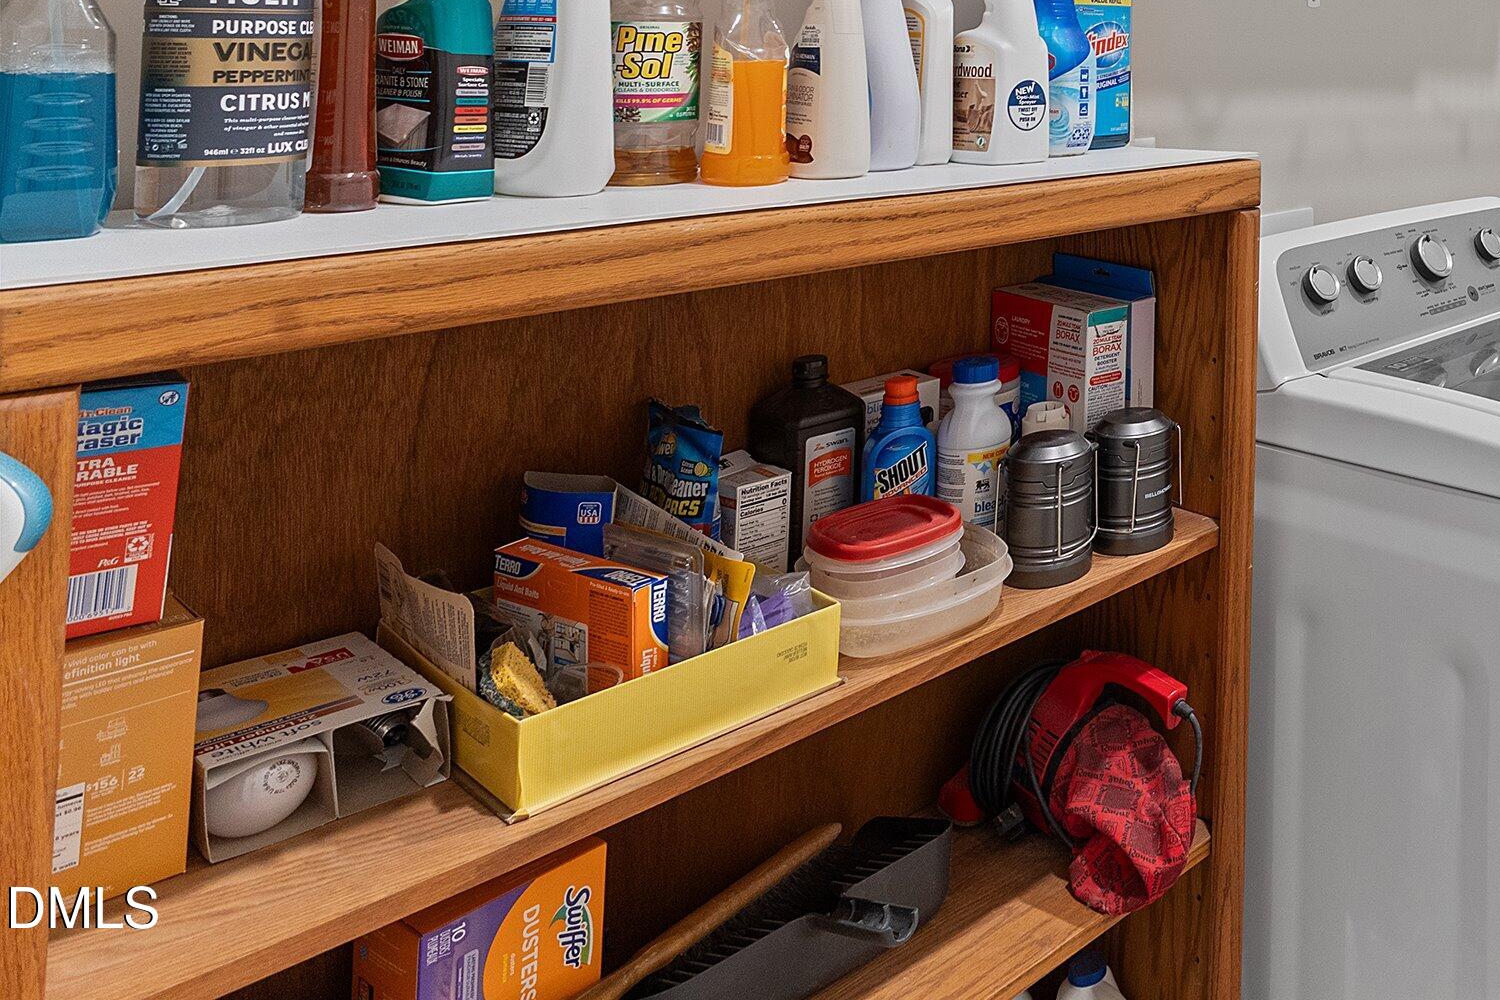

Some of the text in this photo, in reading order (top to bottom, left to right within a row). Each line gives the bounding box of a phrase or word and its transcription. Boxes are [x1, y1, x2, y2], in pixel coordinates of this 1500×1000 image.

[212, 20, 297, 35] PURPOSE
[378, 38, 418, 54] WEIMAN
[616, 26, 684, 53] Pine
[953, 63, 992, 77] rdwood
[376, 74, 399, 86] RANITE
[406, 77, 429, 89] STONE
[1096, 79, 1117, 89] RIGINAL
[220, 92, 300, 112] CITRUS
[267, 141, 293, 154] LUX
[1056, 330, 1080, 342] BORAX
[1093, 343, 1122, 356] BORAX
[1095, 352, 1120, 361] DETERGENT
[96, 406, 133, 416] Clean
[867, 403, 881, 414] bli
[77, 433, 142, 450] raser
[826, 438, 848, 448] swan
[77, 457, 115, 470] TRA
[814, 455, 848, 468] HYDROGEN
[814, 462, 842, 475] PEROXIDE
[877, 442, 928, 494] SHOUT
[76, 464, 138, 482] RABLE
[105, 475, 136, 484] CLEANER
[673, 482, 709, 498] eaner
[742, 479, 787, 495] Nutrition Facts
[741, 508, 764, 517] Calories
[495, 554, 521, 576] TERRO
[497, 581, 540, 599] Liquid Ant Baits
[653, 580, 668, 623] TERRO
[69, 640, 157, 668] vivid color can be with
[64, 653, 140, 680] efinition light
[128, 767, 145, 780] 22
[451, 922, 466, 942] 10
[558, 886, 591, 969] Swiffer
[427, 935, 439, 966] PLUMEAUX
[521, 904, 540, 1000] DUSTERS
